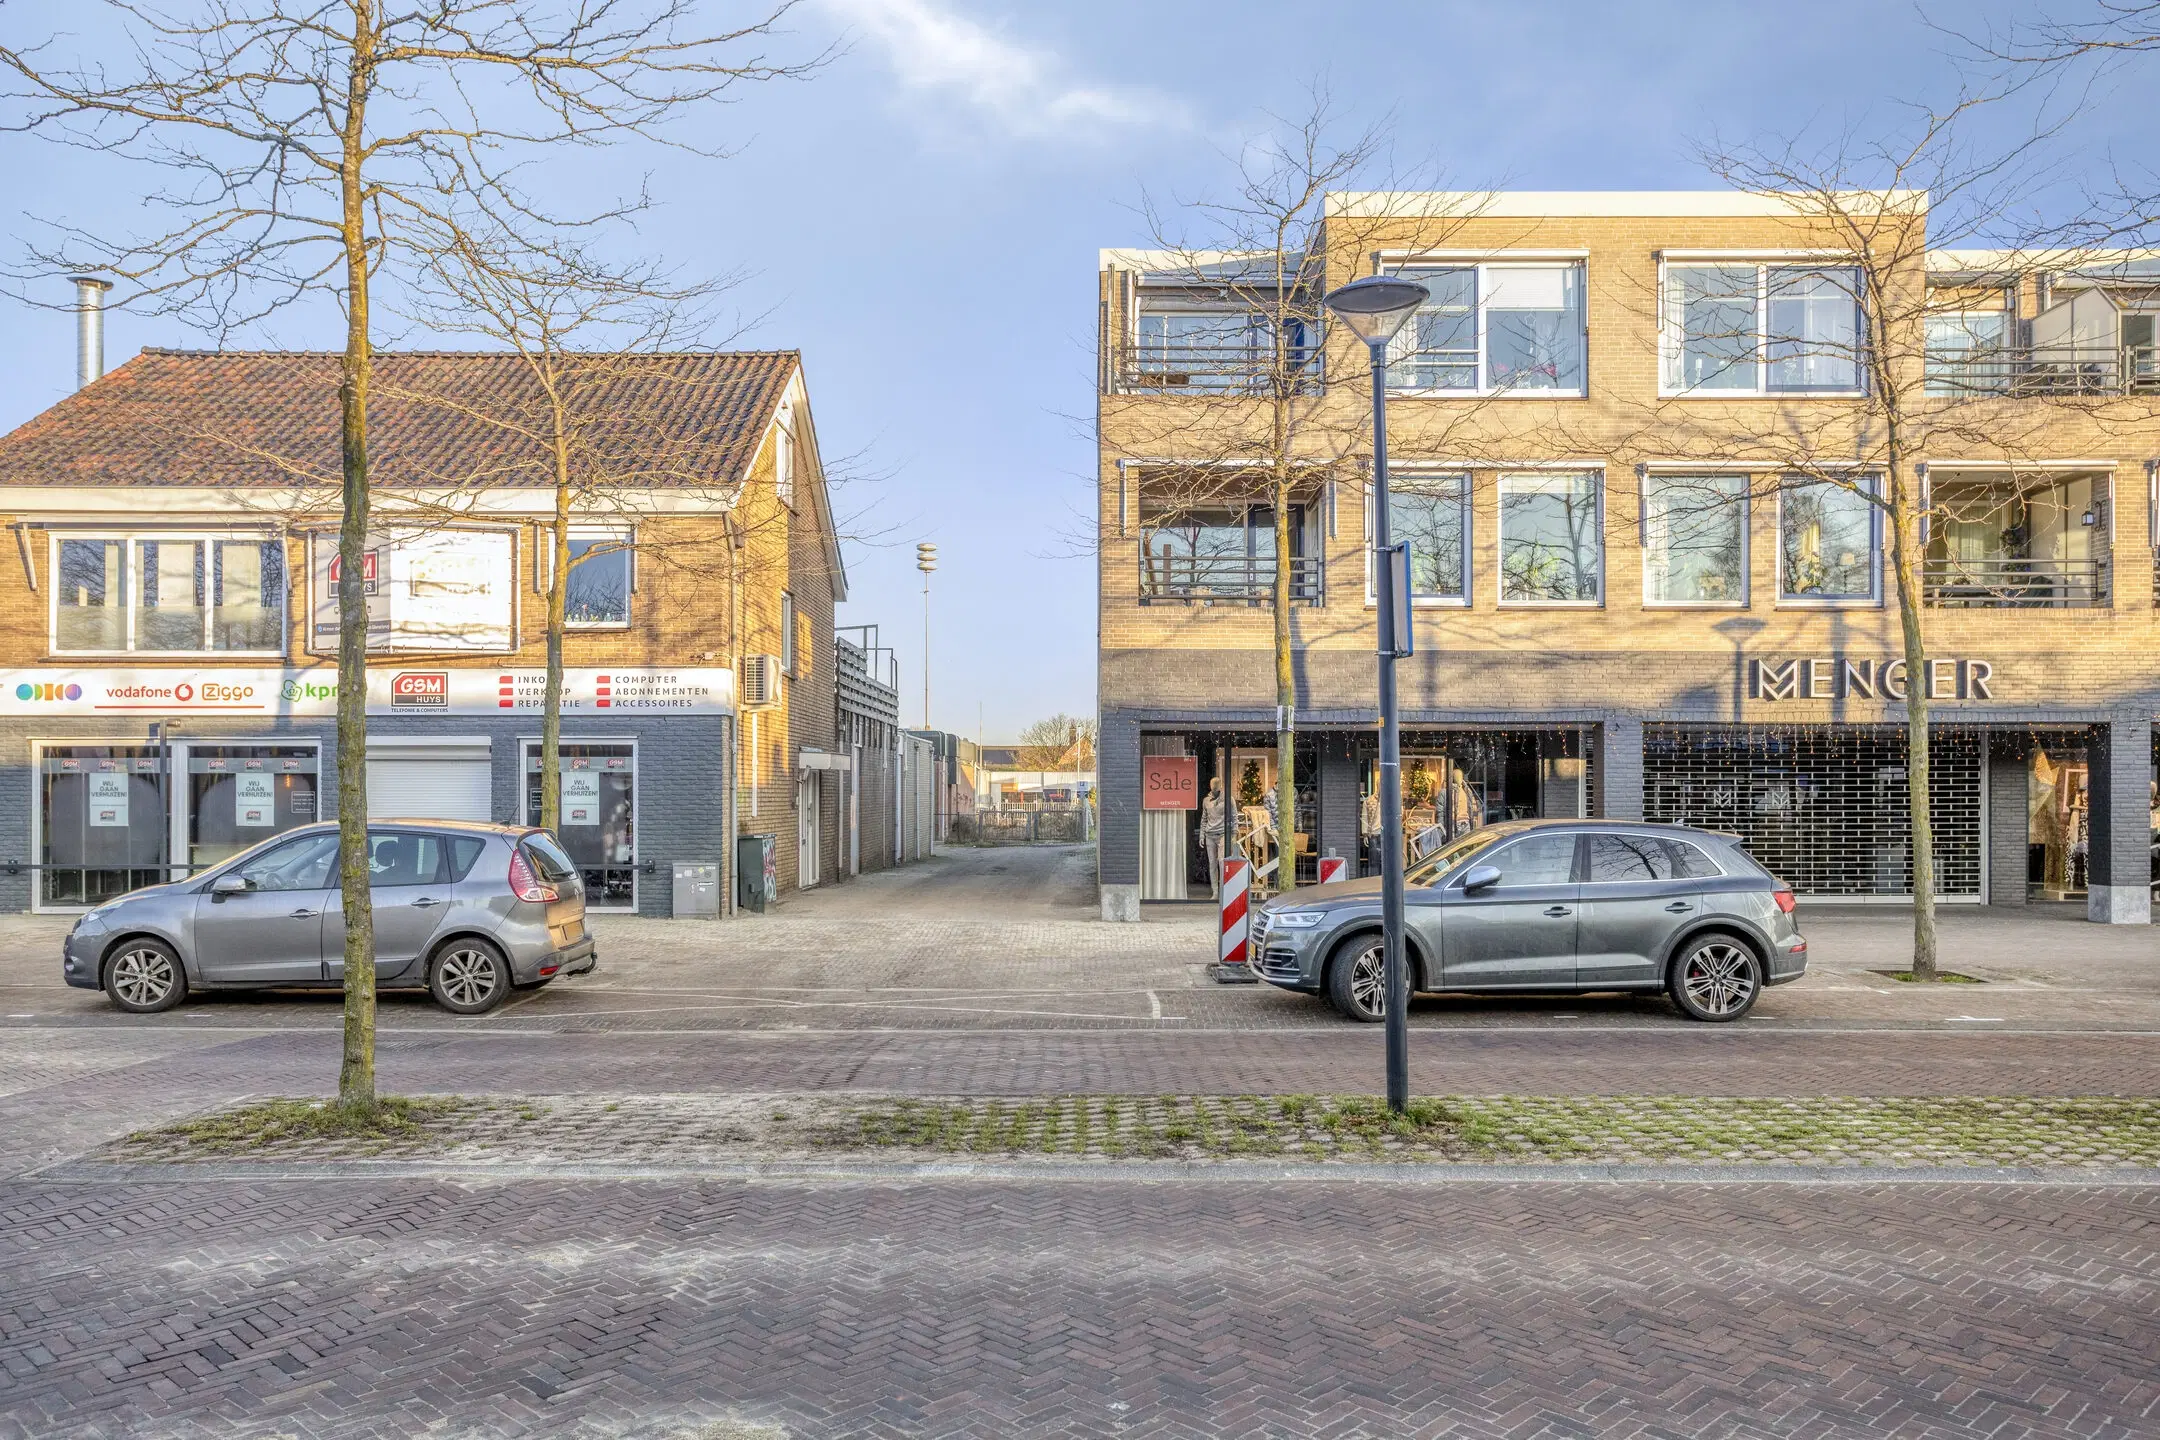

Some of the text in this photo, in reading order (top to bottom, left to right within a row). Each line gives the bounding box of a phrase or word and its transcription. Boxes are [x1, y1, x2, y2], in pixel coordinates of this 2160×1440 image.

[518, 676, 546, 684] INKO
[615, 676, 677, 684] COMPUTER
[1755, 658, 1993, 700] MENGER
[401, 678, 441, 693] GSM
[106, 686, 172, 698] vodafone
[518, 688, 571, 696] VERKP
[1149, 770, 1192, 790] Sale
